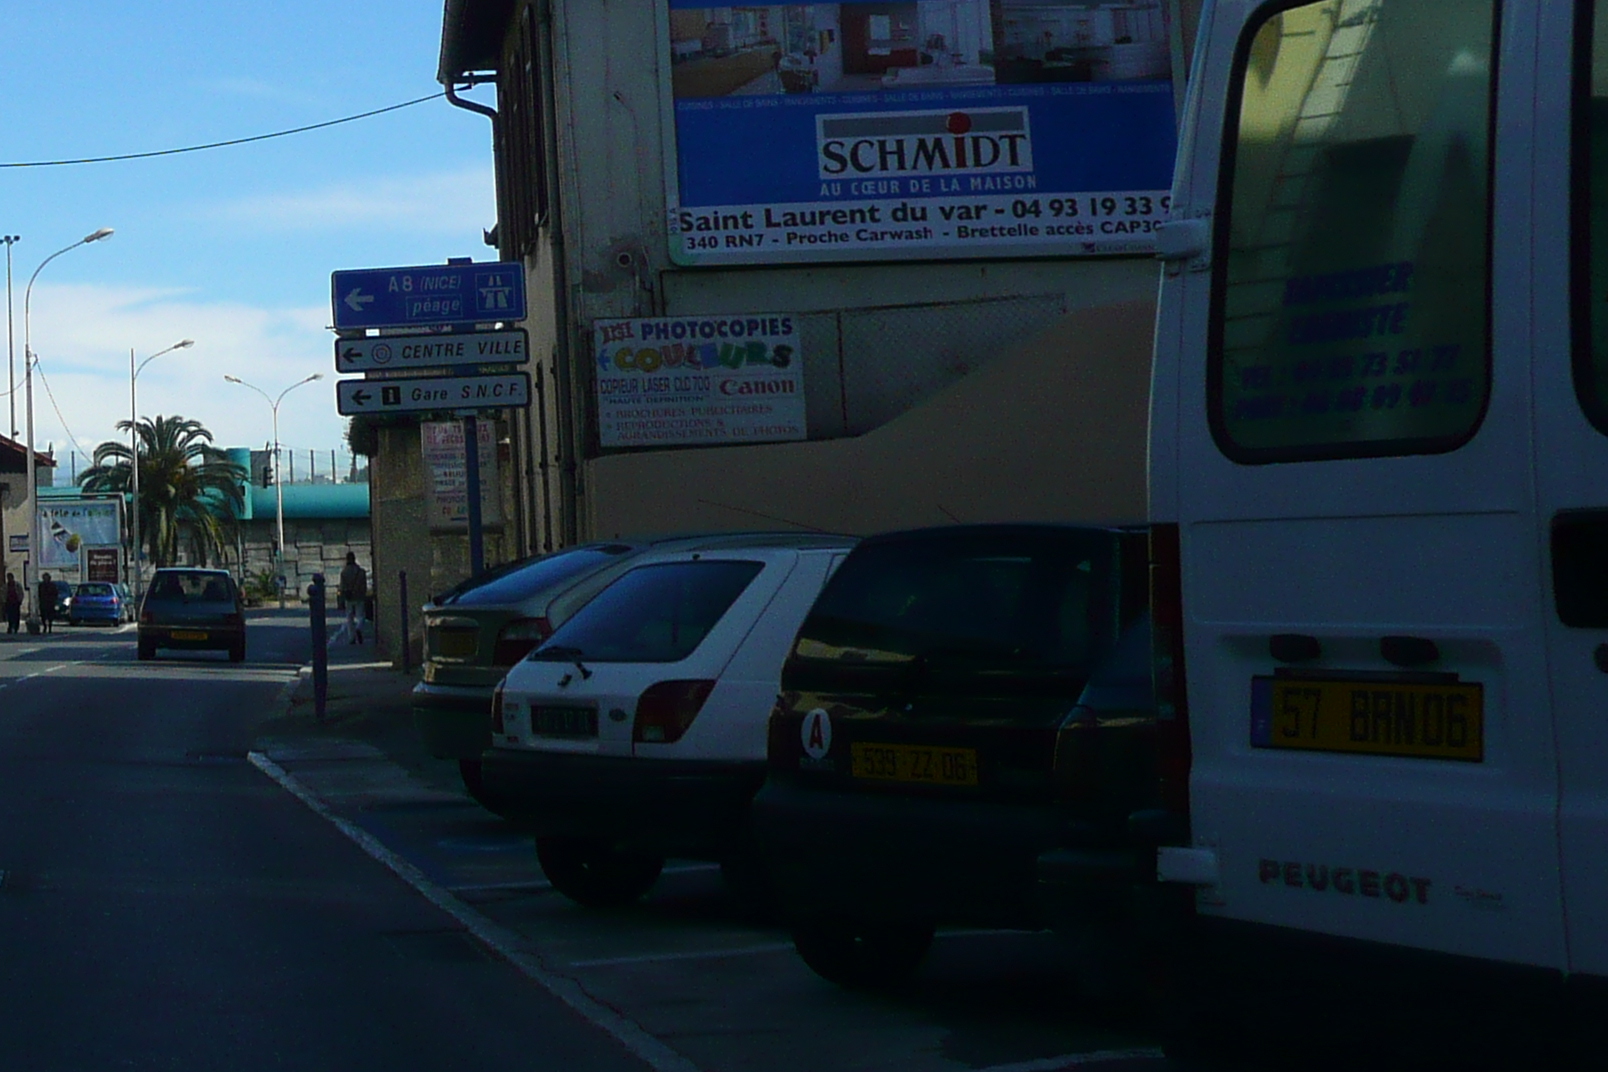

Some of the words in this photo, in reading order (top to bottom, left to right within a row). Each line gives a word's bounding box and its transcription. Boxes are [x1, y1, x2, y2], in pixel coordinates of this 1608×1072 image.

[822, 134, 1027, 174] SCHMIDT
[820, 183, 841, 197] AU
[909, 179, 930, 193] DE
[939, 177, 961, 192] LA
[970, 174, 1037, 190] MAISON
[680, 209, 754, 233] Saint
[764, 205, 881, 229] Laurent
[892, 202, 928, 223] du
[938, 204, 988, 221] var
[1012, 200, 1042, 219] 04
[1048, 199, 1079, 218] 93
[1088, 197, 1117, 217] 19
[1123, 196, 1153, 216] 33
[687, 236, 719, 251] 340
[725, 234, 765, 249] RN7
[786, 228, 850, 245] Proche
[855, 224, 933, 242] Carwash
[957, 222, 1040, 239] Brettelle
[1045, 220, 1094, 237] accès
[412, 299, 461, 316] péage
[641, 318, 793, 340] PHOTOCOPIES
[402, 343, 465, 359] CENTRE
[478, 340, 522, 355] VILLE
[614, 341, 794, 373] COULEURS
[412, 388, 448, 402] Gare
[600, 379, 638, 394] COPIEUR
[643, 378, 670, 392] LASER
[719, 378, 795, 396] Canon
[1283, 688, 1321, 738] 57
[809, 714, 823, 748] A
[942, 753, 967, 780] 06
[1259, 858, 1430, 905] PEUGEOT
